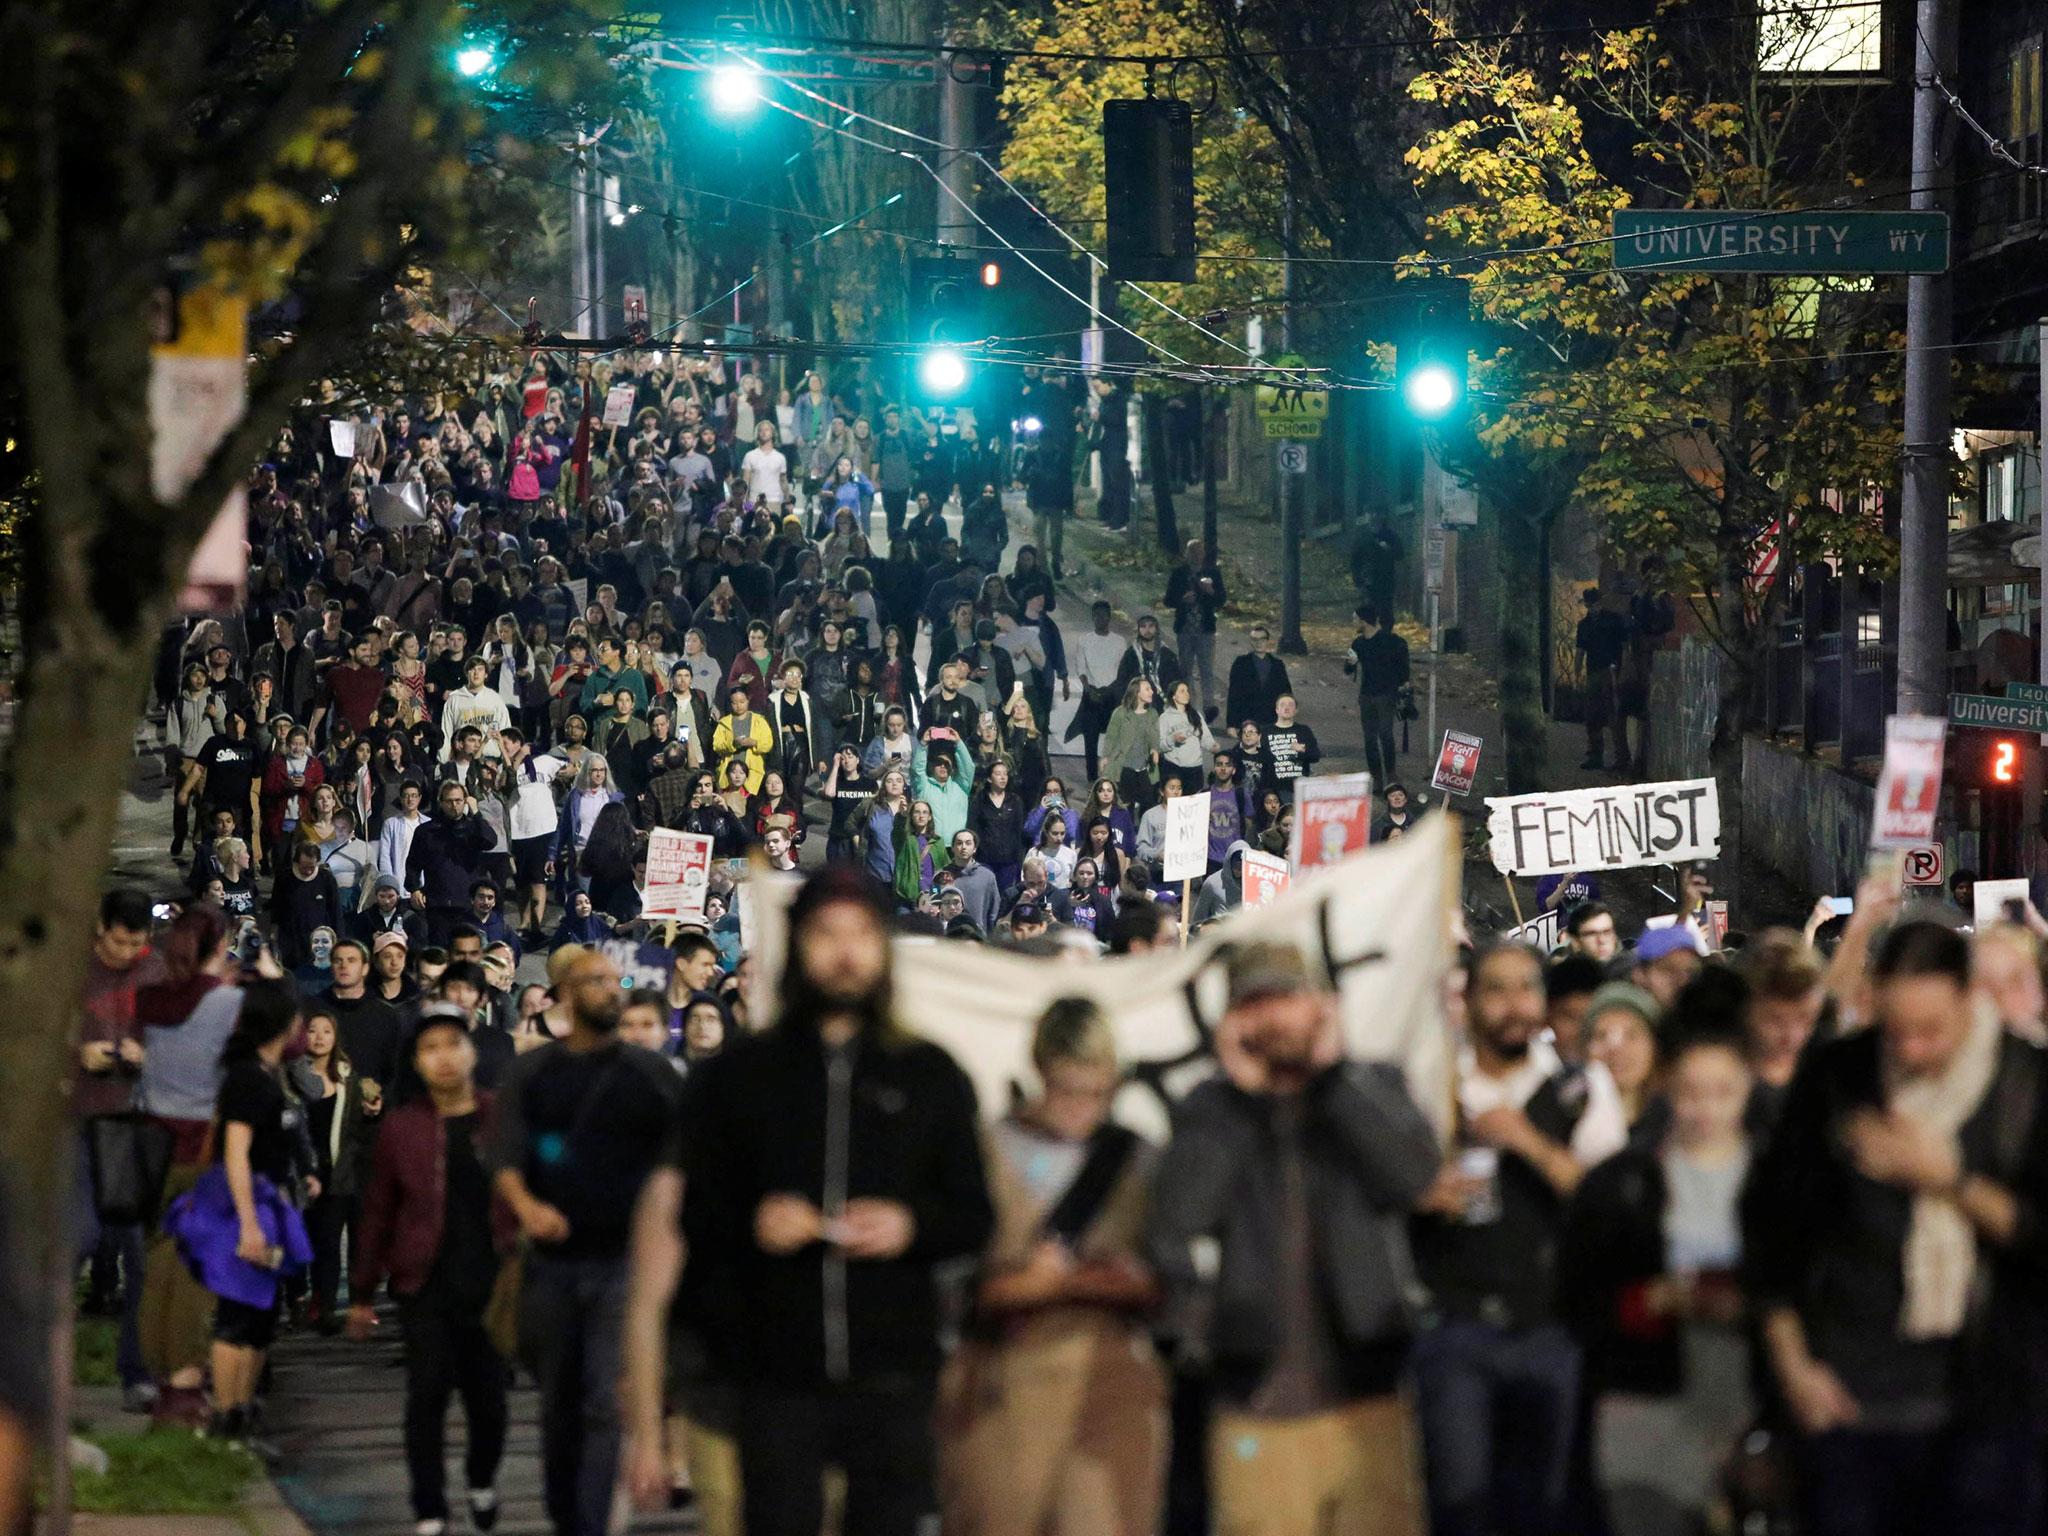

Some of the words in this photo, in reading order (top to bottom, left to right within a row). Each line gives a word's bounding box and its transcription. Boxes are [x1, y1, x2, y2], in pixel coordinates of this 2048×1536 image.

[1634, 224, 1850, 255] UNIVERSITY
[1888, 229, 1928, 253] WY
[1268, 423, 1318, 435] SCHOOL
[1446, 740, 1478, 758] FIGHT
[1995, 742, 2014, 781] 2
[1510, 787, 1707, 870] FEMINIST
[1248, 864, 1284, 885] FIGHT
